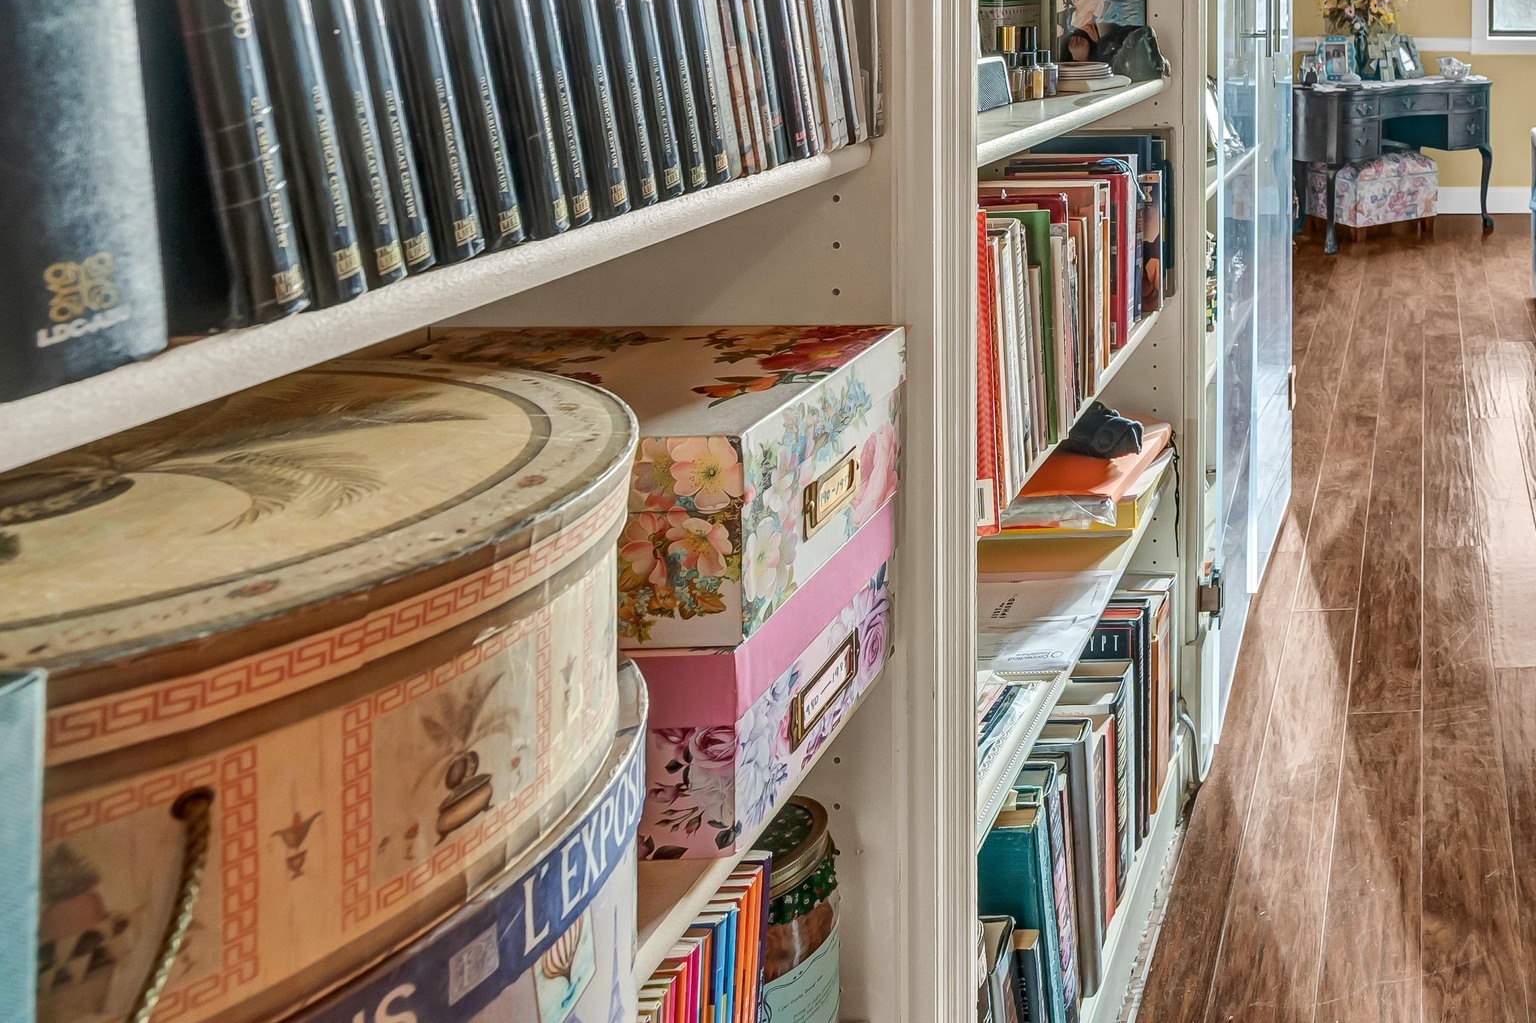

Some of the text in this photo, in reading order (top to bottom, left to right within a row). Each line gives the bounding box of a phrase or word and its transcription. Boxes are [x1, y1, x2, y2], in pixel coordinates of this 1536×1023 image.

[701, 48, 722, 139] OUR AMERICAN CENTURY
[650, 56, 672, 153] OUR AMERICAN CENTURY
[677, 58, 699, 152] OUR AMERICAN CENTURY
[555, 70, 581, 178] OUR AMERICAN CENTURY
[761, 109, 773, 136] VIKING
[610, 181, 626, 194] TIME
[571, 191, 588, 204] TIME
[612, 191, 628, 205] LIFE
[498, 205, 517, 225] TIME
[574, 201, 591, 216] LIFE
[453, 215, 474, 233] TIME
[1089, 634, 1119, 652] YPT
[1007, 654, 1049, 662] Connecticut
